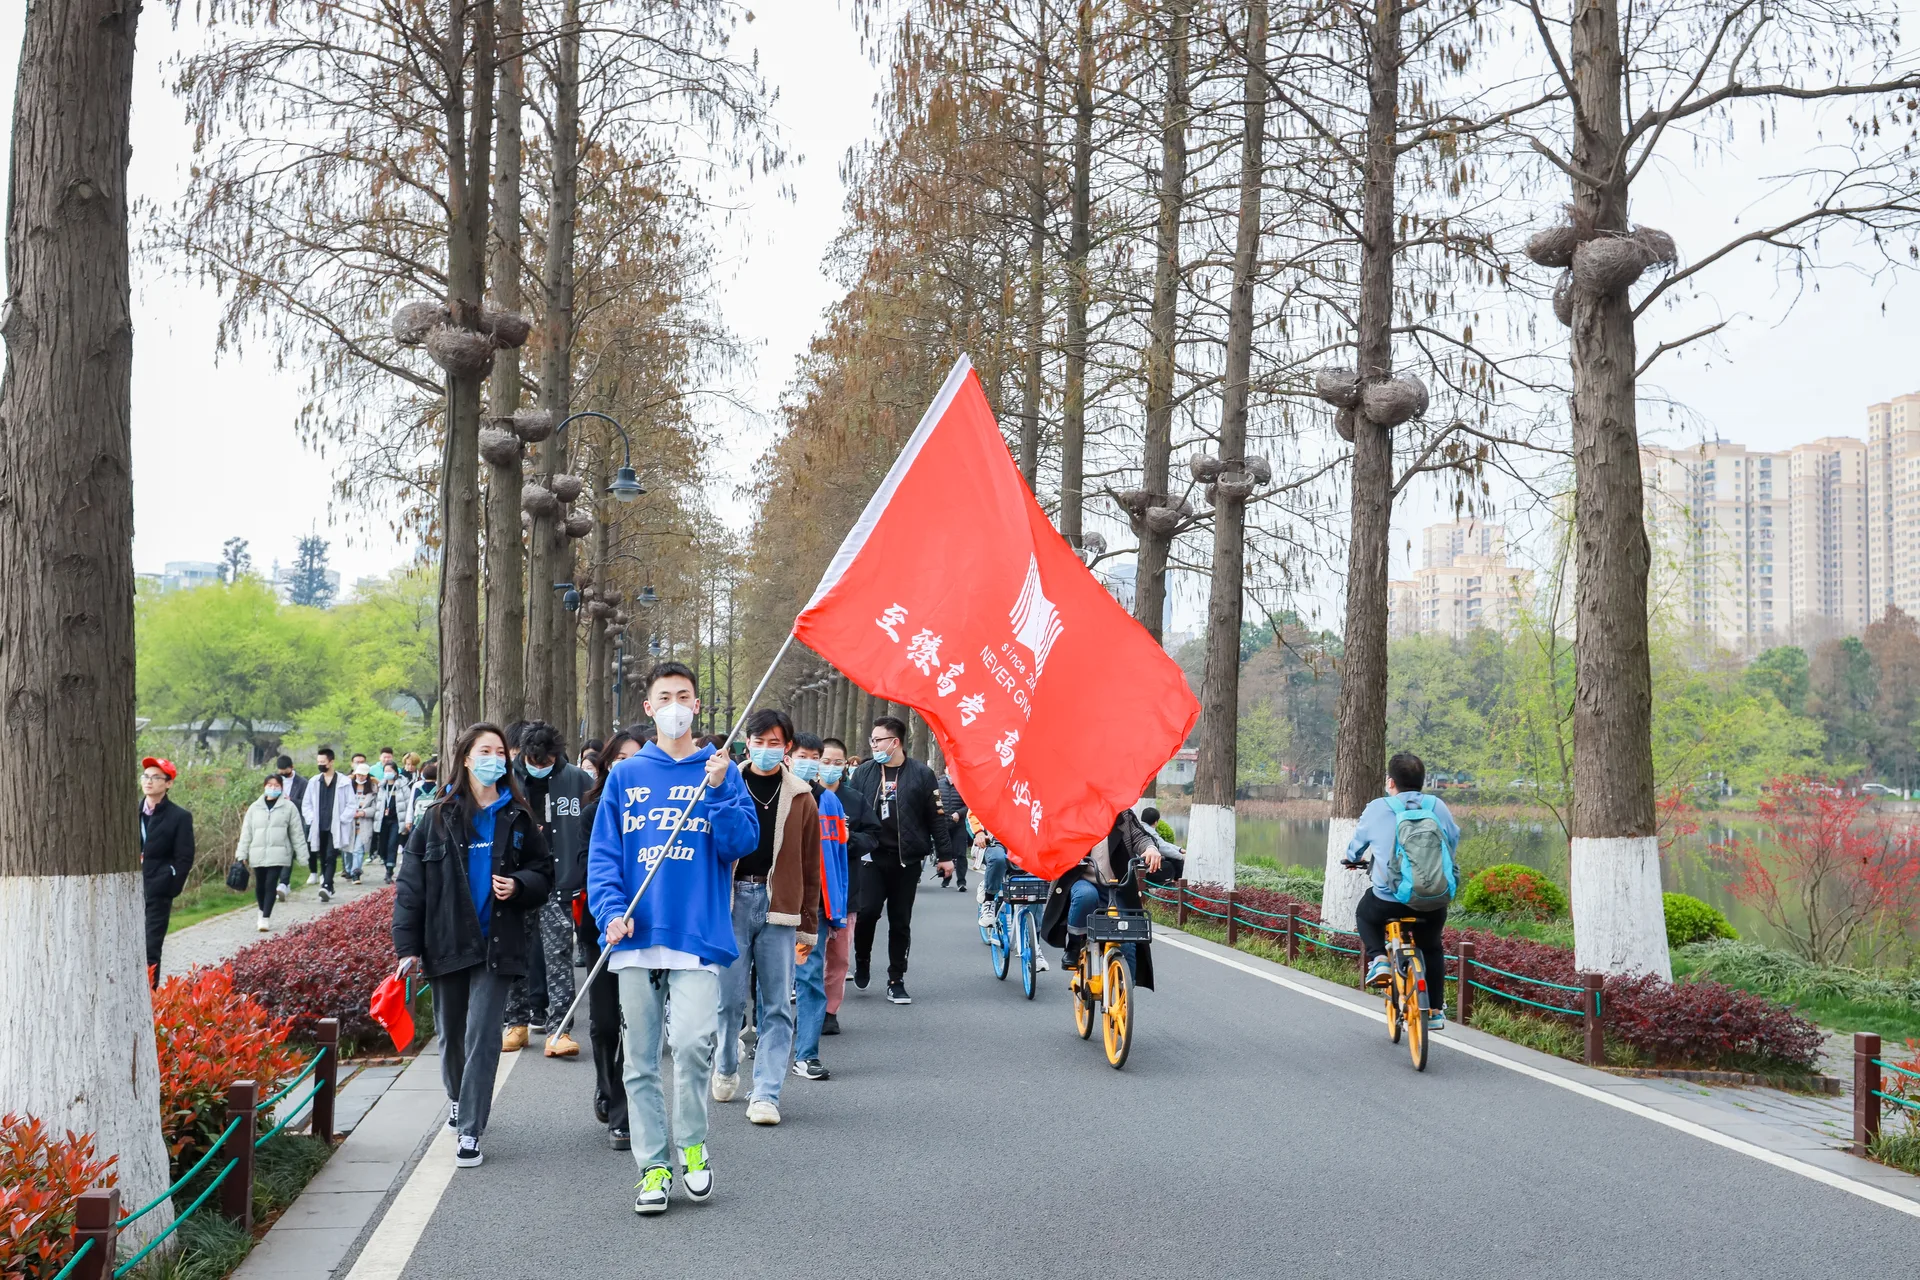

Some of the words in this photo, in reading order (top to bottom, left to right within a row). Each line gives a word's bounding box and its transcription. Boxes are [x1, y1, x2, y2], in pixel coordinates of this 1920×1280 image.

[979, 644, 1016, 694] NEVER
[1001, 642, 1026, 674] since
[624, 785, 651, 807] ye
[622, 810, 646, 835] be
[648, 807, 711, 835] Born
[637, 839, 695, 872] again
